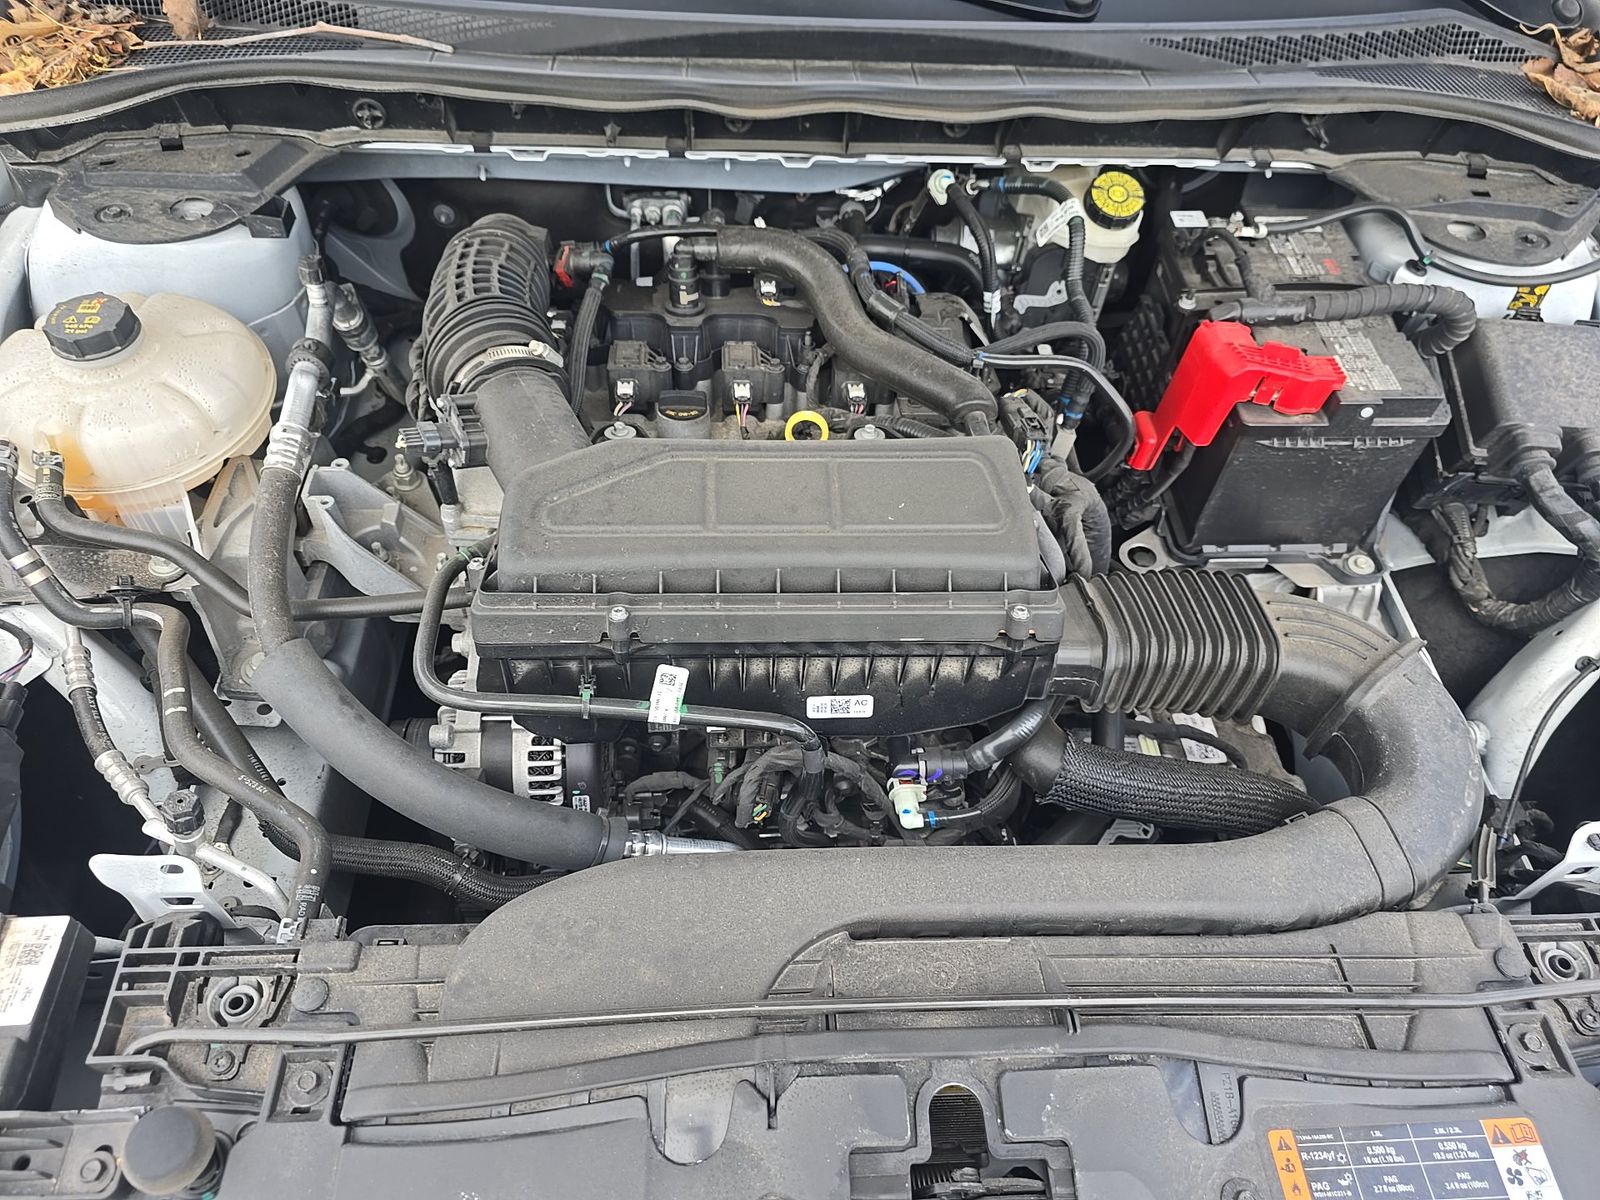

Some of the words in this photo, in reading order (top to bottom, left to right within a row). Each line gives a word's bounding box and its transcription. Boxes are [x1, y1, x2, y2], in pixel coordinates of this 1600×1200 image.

[298, 902, 308, 917] RAD
[1366, 1146, 1386, 1154] 0.500
[1385, 1145, 1396, 1156] kg
[1456, 1141, 1468, 1152] kg
[1300, 1150, 1336, 1162] R-1234yf
[1383, 1174, 1398, 1183] PAG
[1456, 1172, 1471, 1180] PAG
[1311, 1181, 1330, 1191] PAG
